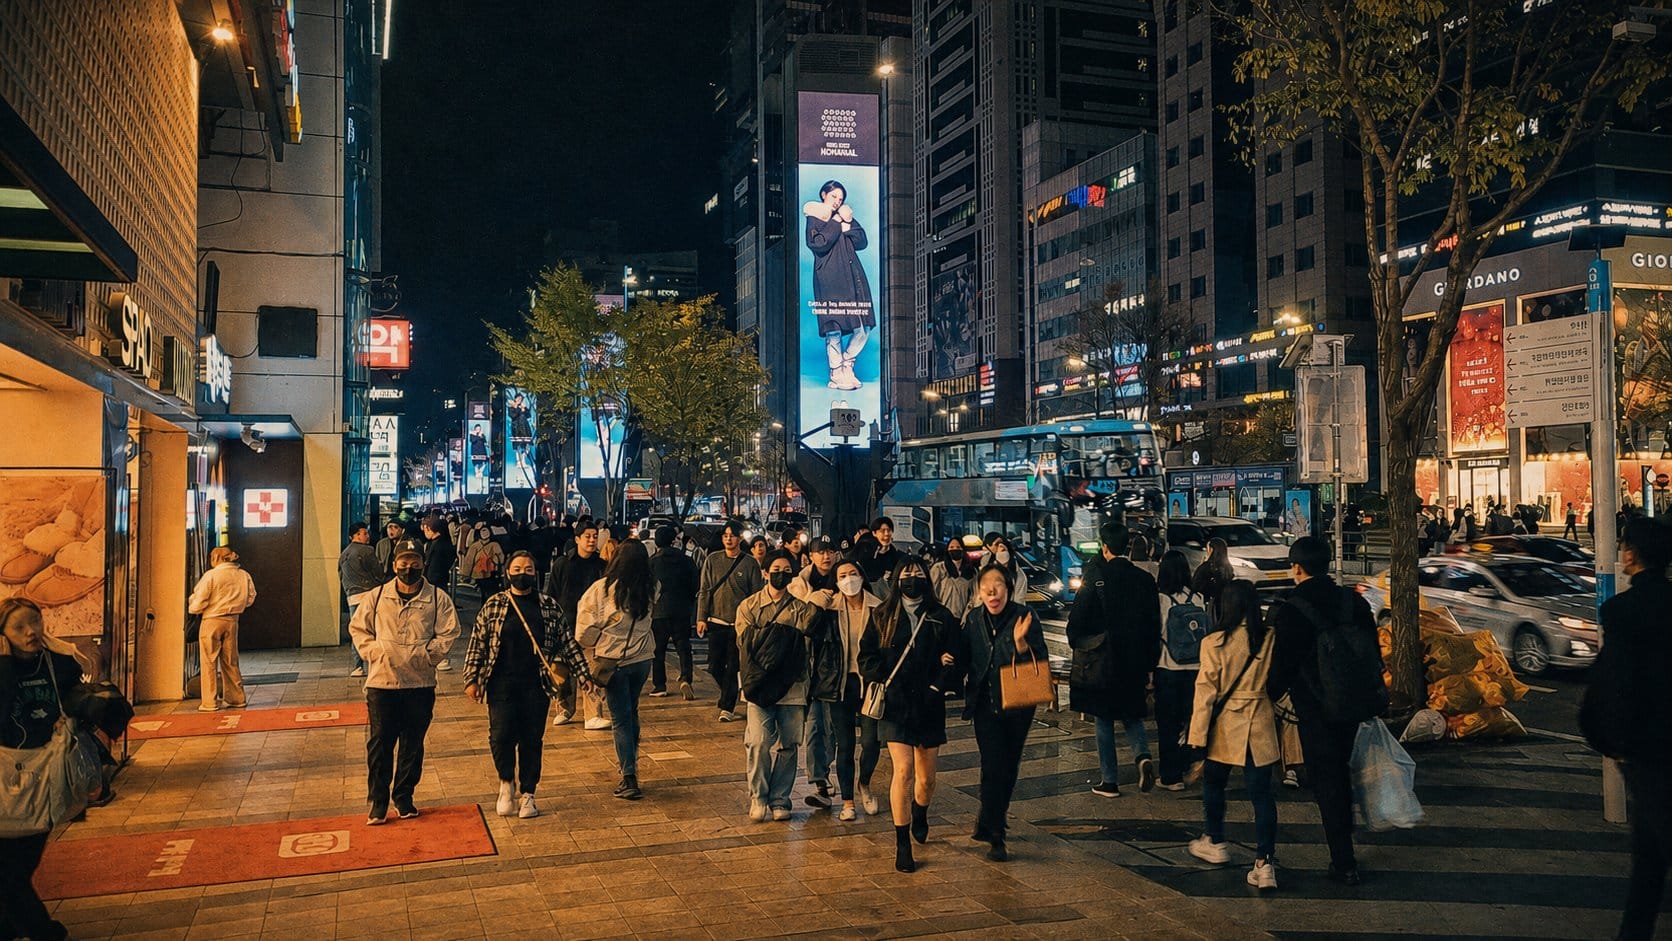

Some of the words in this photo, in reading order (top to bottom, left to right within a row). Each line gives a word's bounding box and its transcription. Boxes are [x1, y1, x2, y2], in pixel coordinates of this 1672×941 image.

[1631, 252, 1672, 268] GIO
[1434, 268, 1520, 296] GRDANO
[121, 294, 153, 379] SPAO
